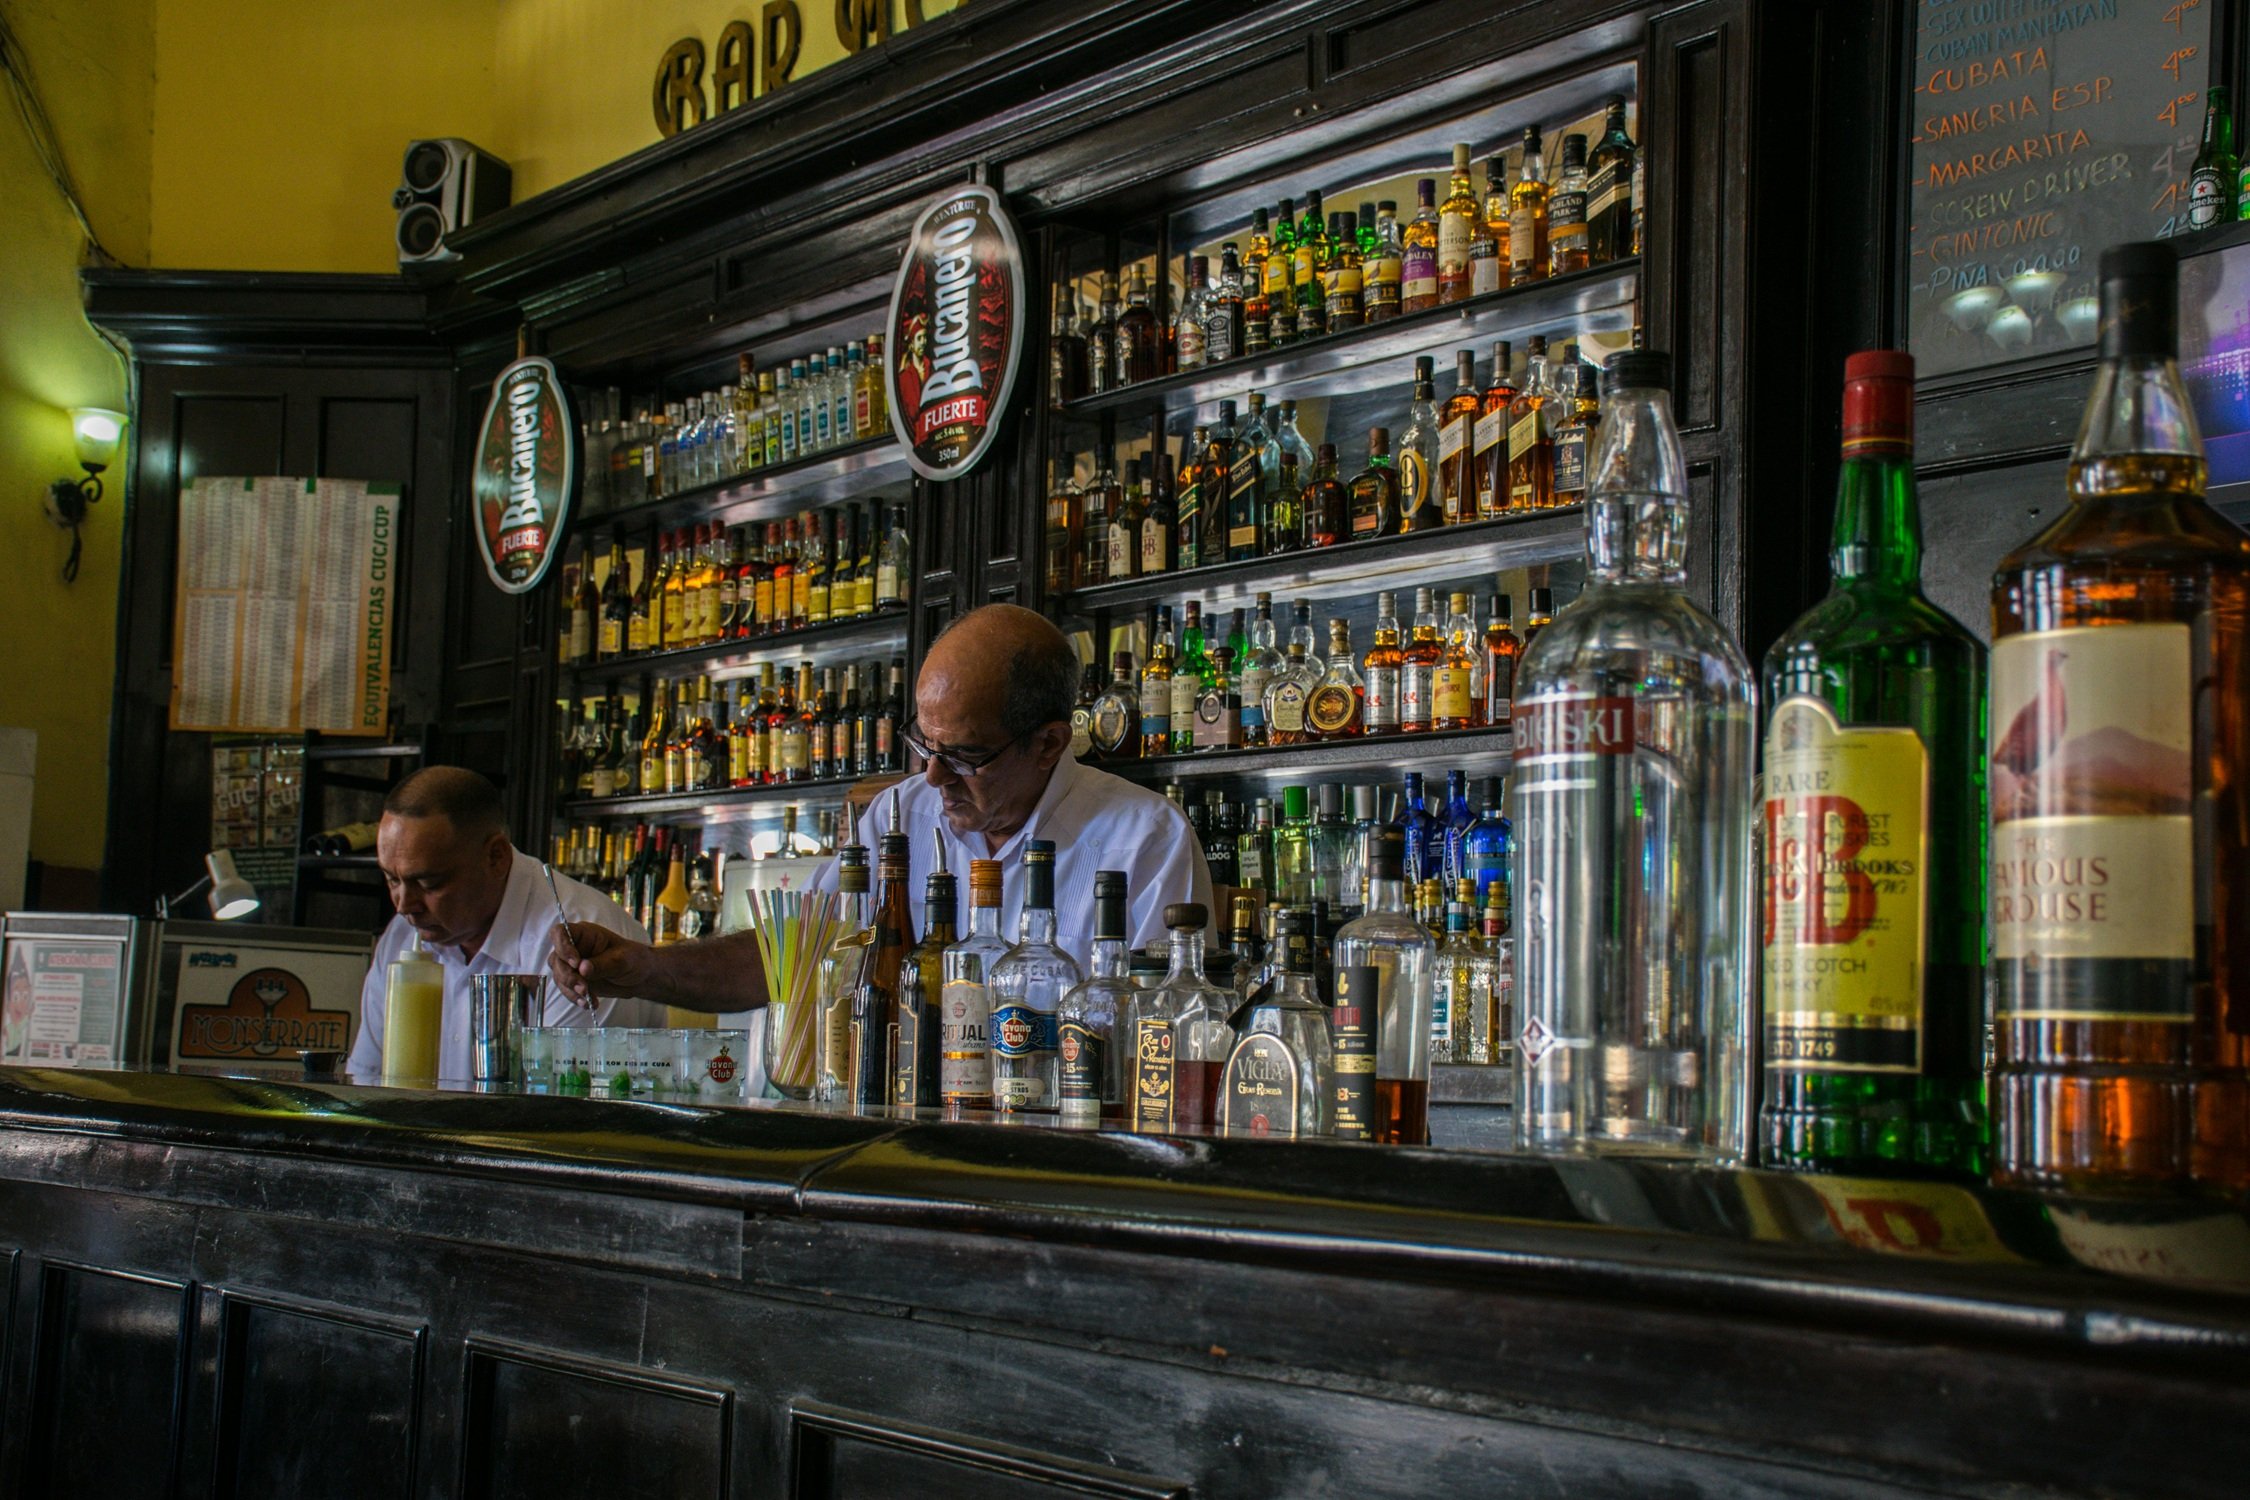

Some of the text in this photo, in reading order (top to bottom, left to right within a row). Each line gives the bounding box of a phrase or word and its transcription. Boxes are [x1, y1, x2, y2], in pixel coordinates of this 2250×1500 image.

[653, 0, 801, 138] BAR
[920, 217, 983, 408] Bucanero
[924, 398, 978, 432] FUERTE
[499, 381, 544, 533] Bucanero
[502, 529, 541, 554] FUERTE
[364, 504, 391, 728] EQUIVALENCIAS CUC/CUP
[1772, 771, 1831, 794] RARE
[1206, 852, 1230, 861] LLDOG
[1995, 856, 2109, 889] AMOUS
[1797, 957, 1867, 974] COTCH
[190, 1015, 343, 1054] MONSERRATE
[1005, 1032, 1024, 1043] Club
[1798, 1041, 1836, 1058] 1749
[704, 1059, 739, 1069] Havana
[711, 1068, 732, 1080] Club
[1066, 1062, 1076, 1074] 15
